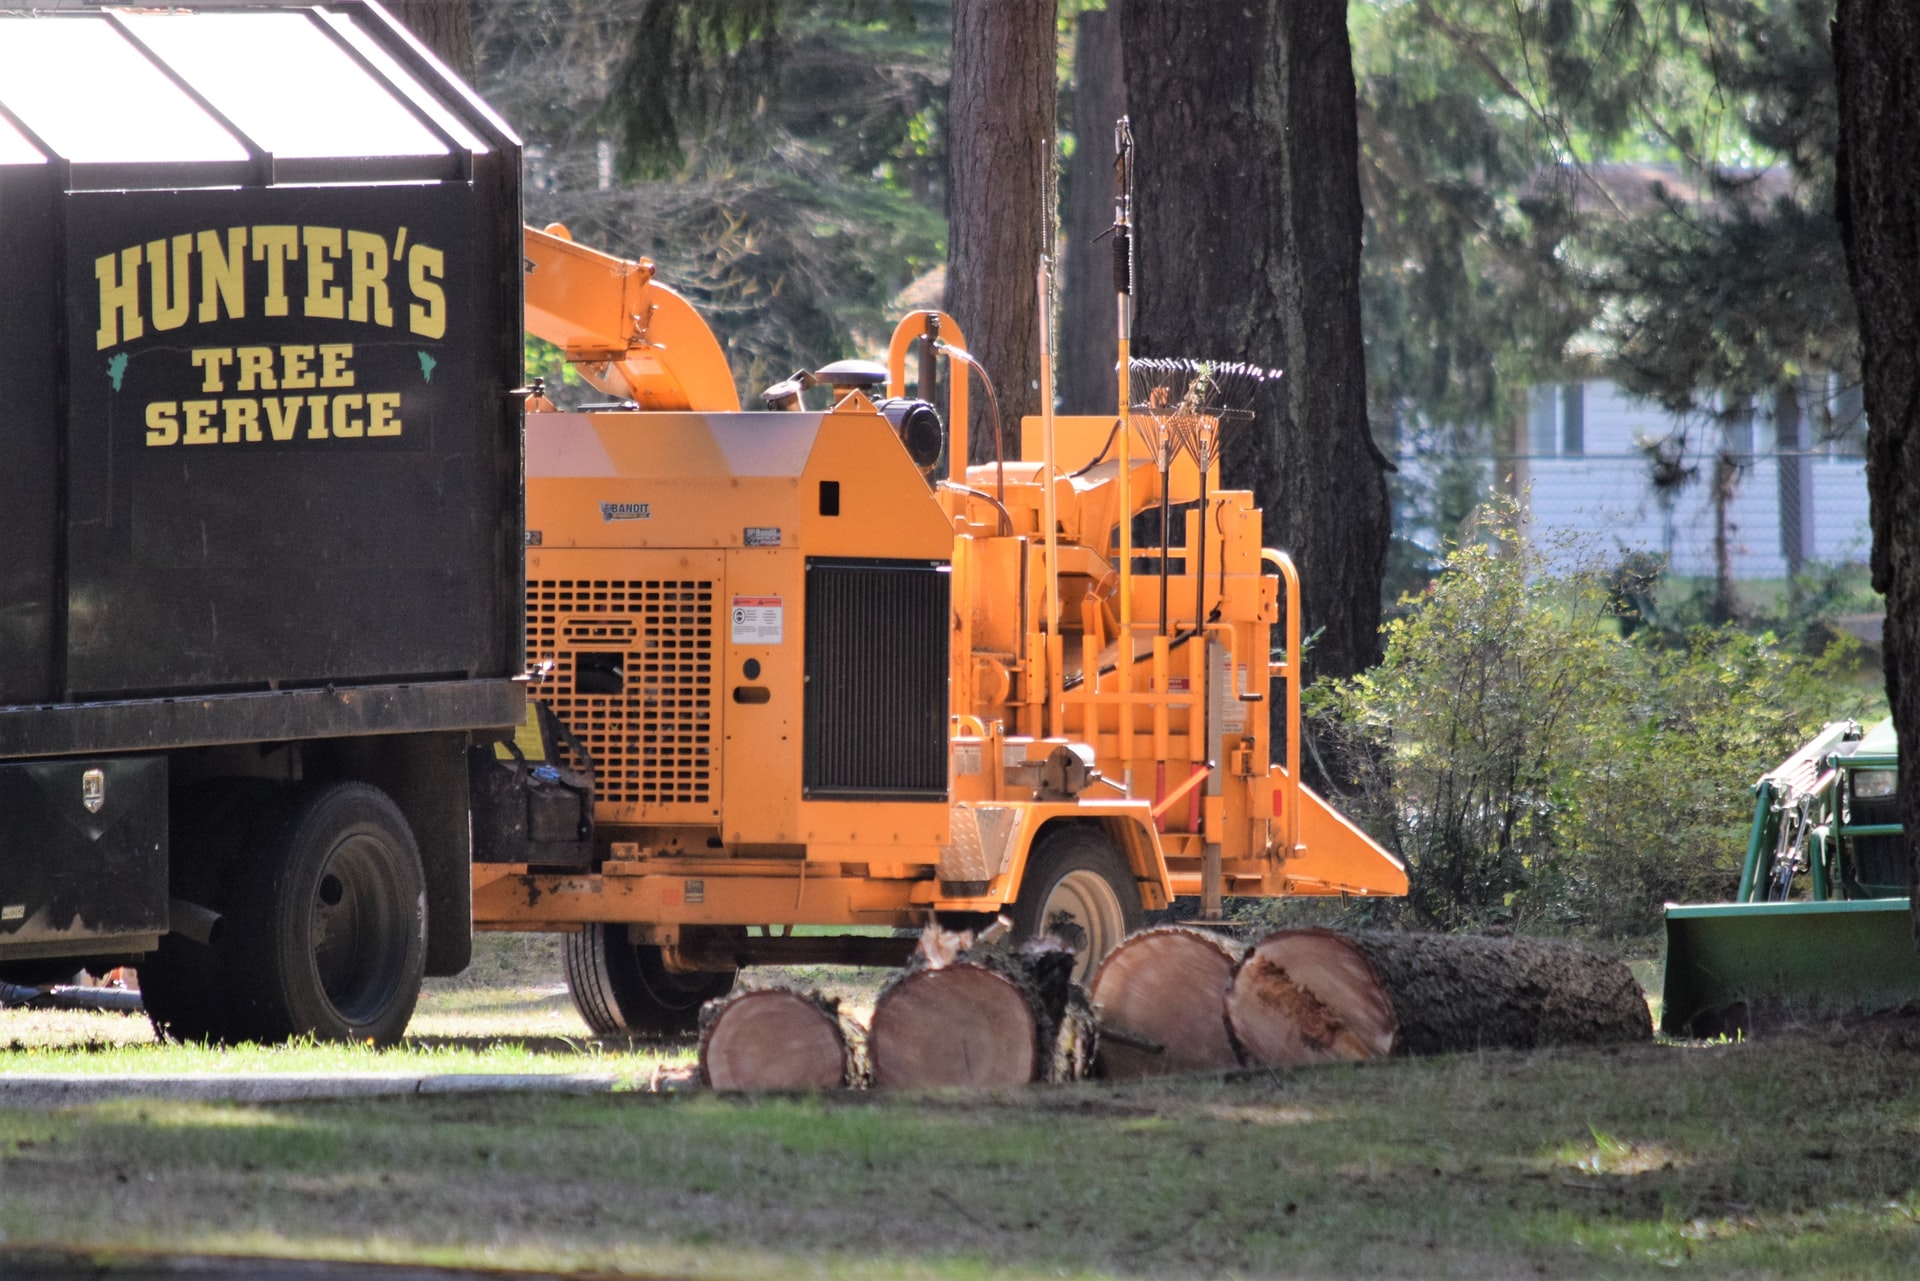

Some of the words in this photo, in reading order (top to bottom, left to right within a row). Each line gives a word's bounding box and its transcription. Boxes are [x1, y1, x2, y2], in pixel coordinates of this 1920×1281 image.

[95, 225, 447, 351] HUNTER'S
[192, 343, 355, 392] TREE
[145, 393, 402, 447] SERVICE
[611, 503, 649, 513] BANDIT
